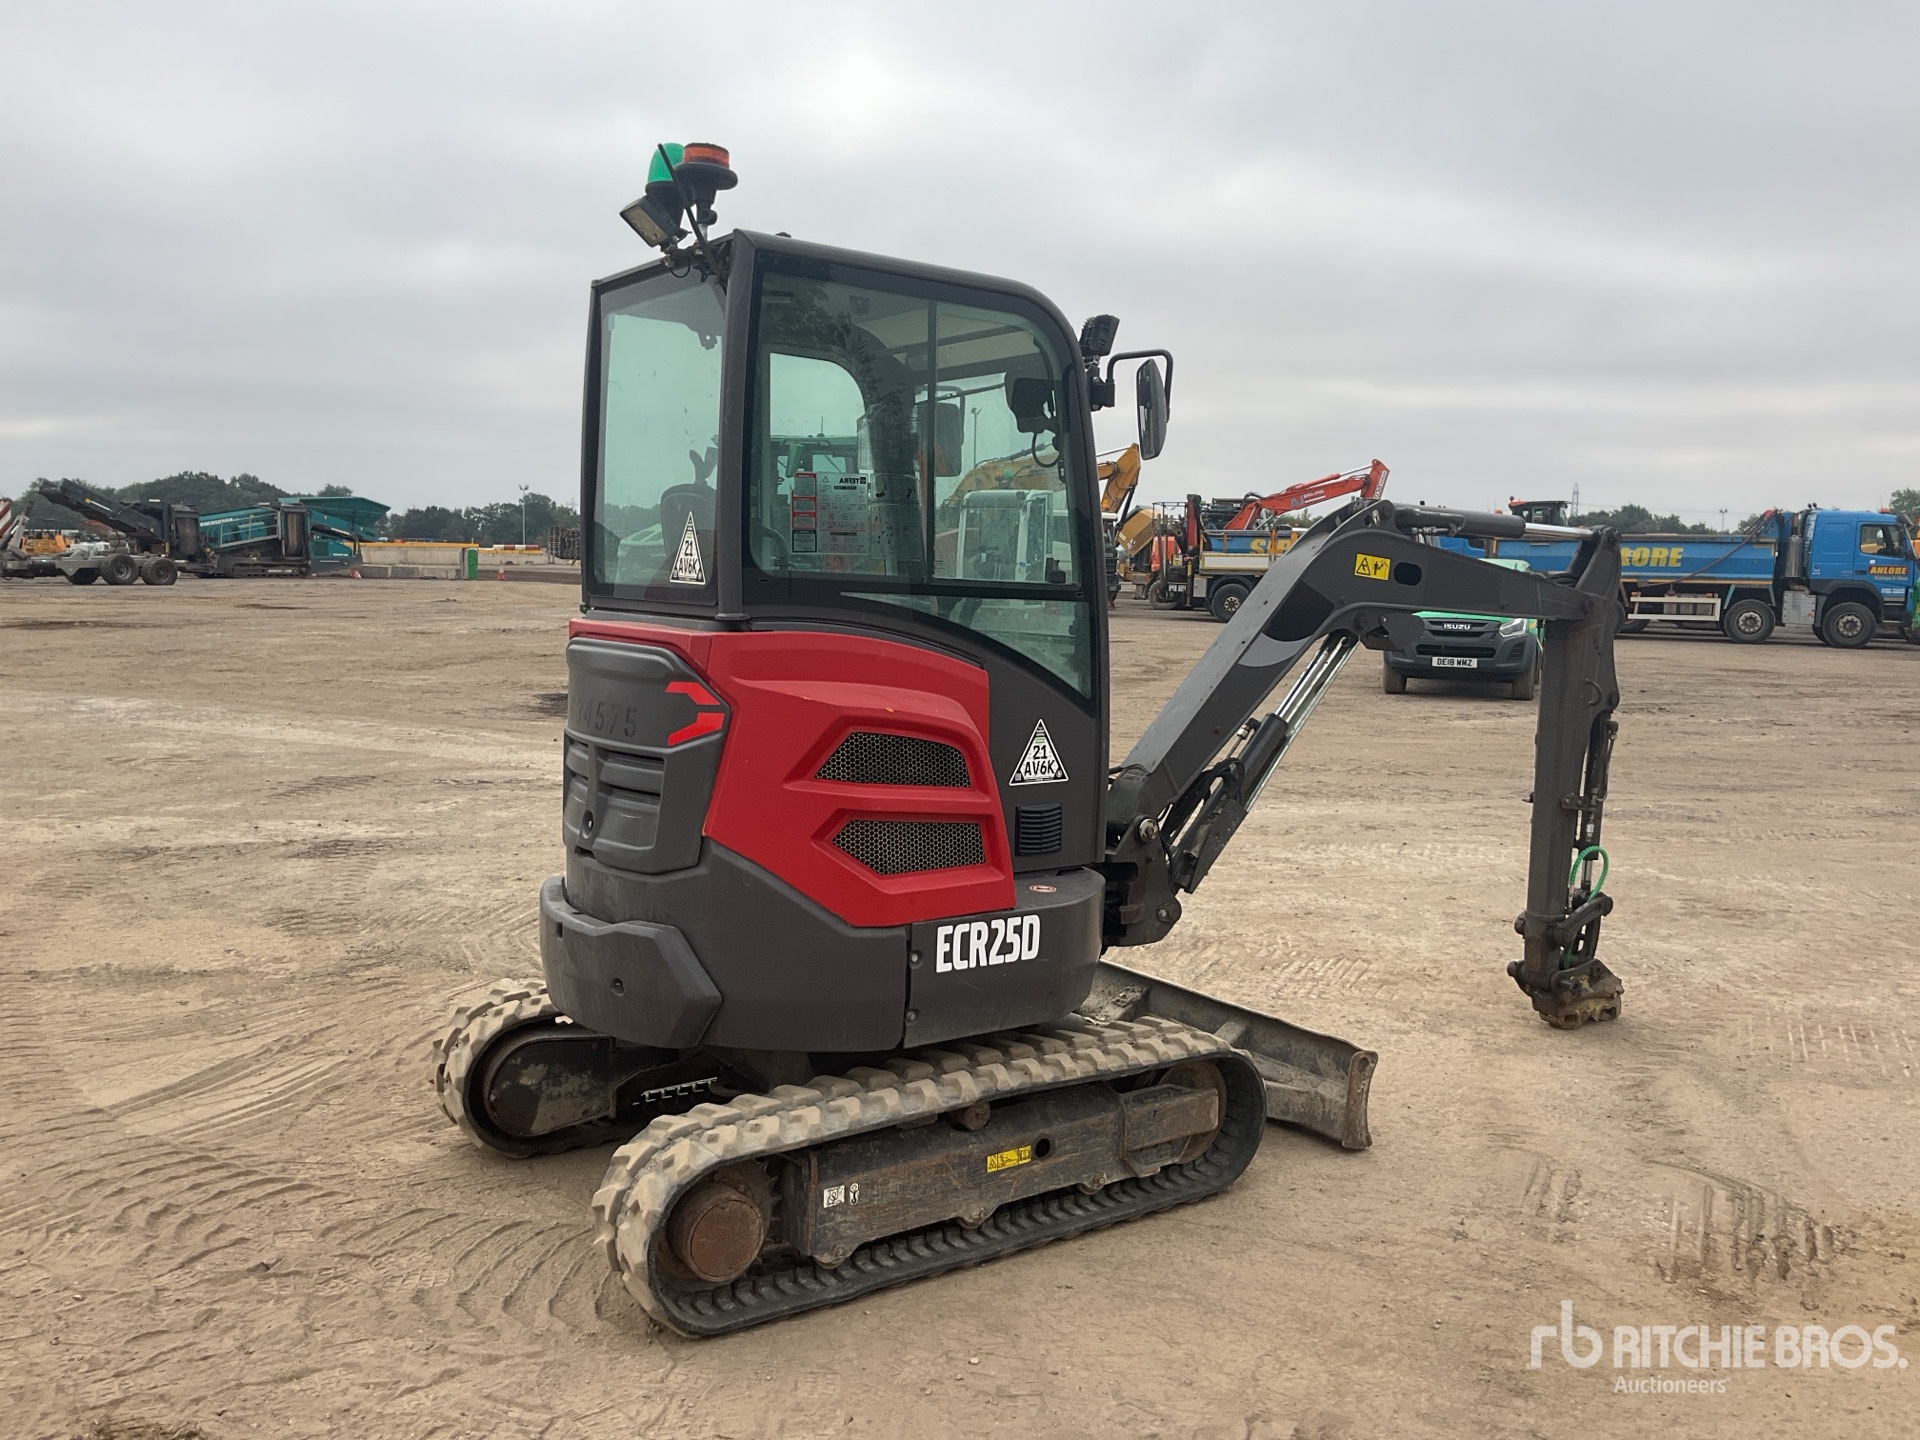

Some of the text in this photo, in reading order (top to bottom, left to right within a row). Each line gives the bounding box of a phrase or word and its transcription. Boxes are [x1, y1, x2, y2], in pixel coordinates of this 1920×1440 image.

[684, 540, 694, 556] 21
[678, 557, 698, 575] AV6K
[1870, 566, 1908, 575] ANLORE
[1437, 658, 1454, 666] DE18
[1033, 745, 1047, 759] 21
[1025, 760, 1055, 776] AV6K
[936, 914, 1041, 973] ECR25D
